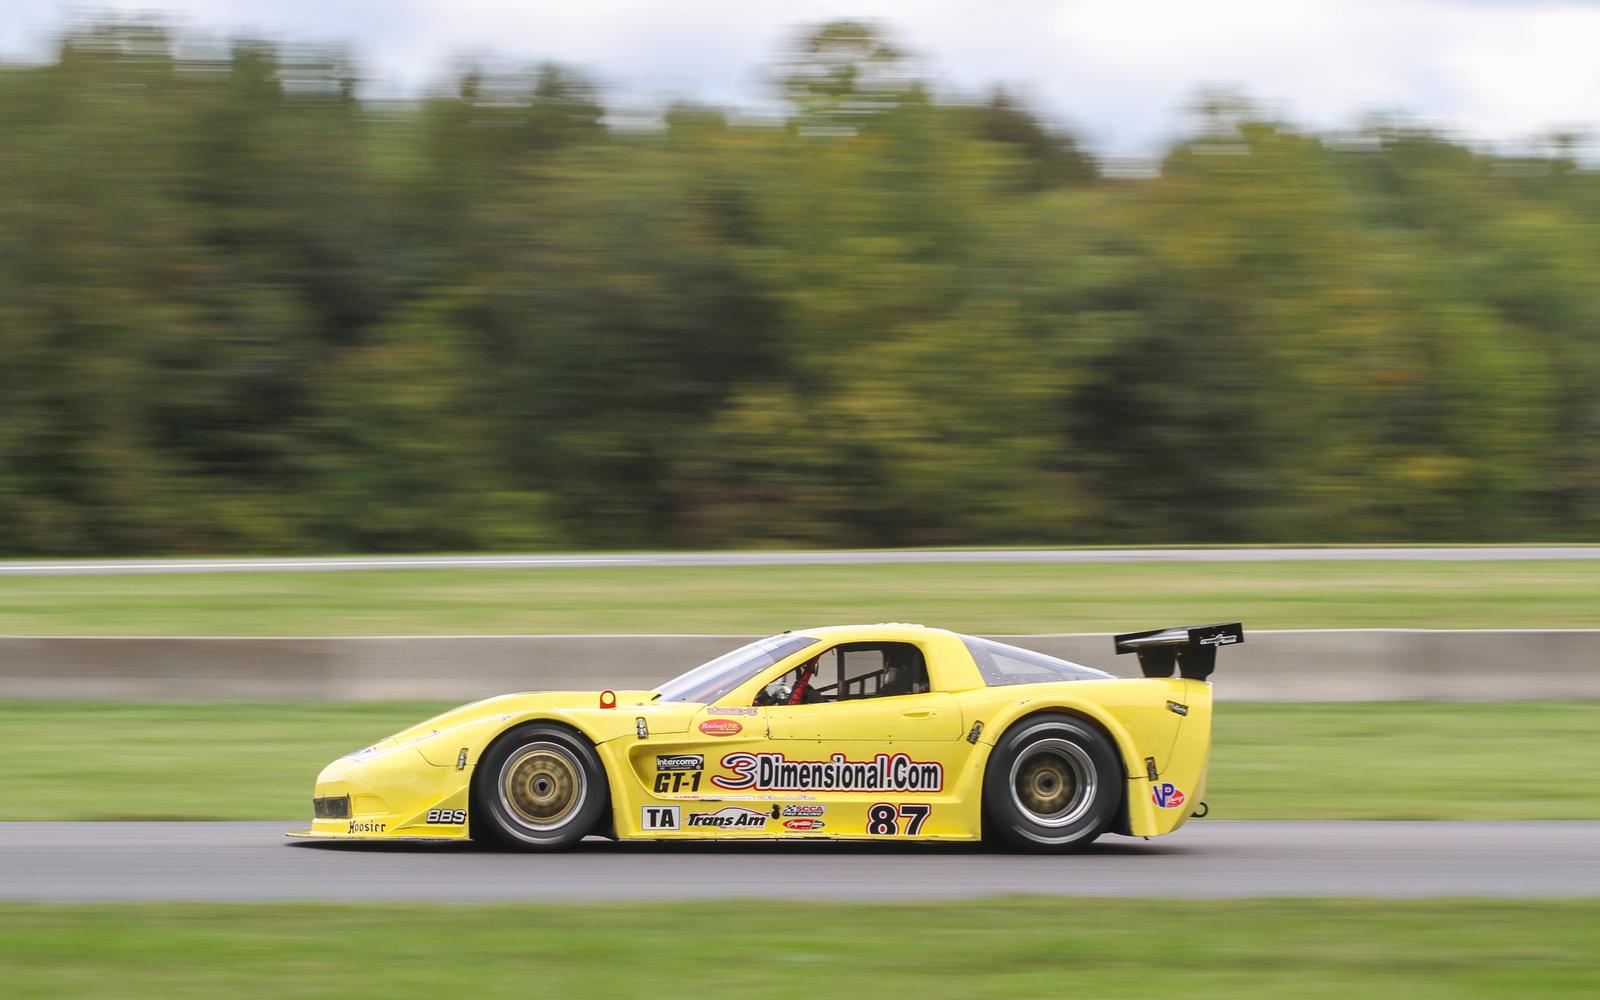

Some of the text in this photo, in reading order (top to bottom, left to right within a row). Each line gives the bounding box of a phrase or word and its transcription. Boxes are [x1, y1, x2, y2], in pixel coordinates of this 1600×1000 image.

[657, 757, 699, 769] Intercomp
[711, 752, 943, 792] 3Dimensional.Com
[653, 771, 702, 793] GT-1
[1153, 783, 1175, 807] VP
[427, 809, 467, 824] BBS
[647, 809, 675, 828] TA
[688, 813, 766, 827] Trans Am
[867, 802, 931, 836] 87
[348, 820, 386, 834] Hoosier
